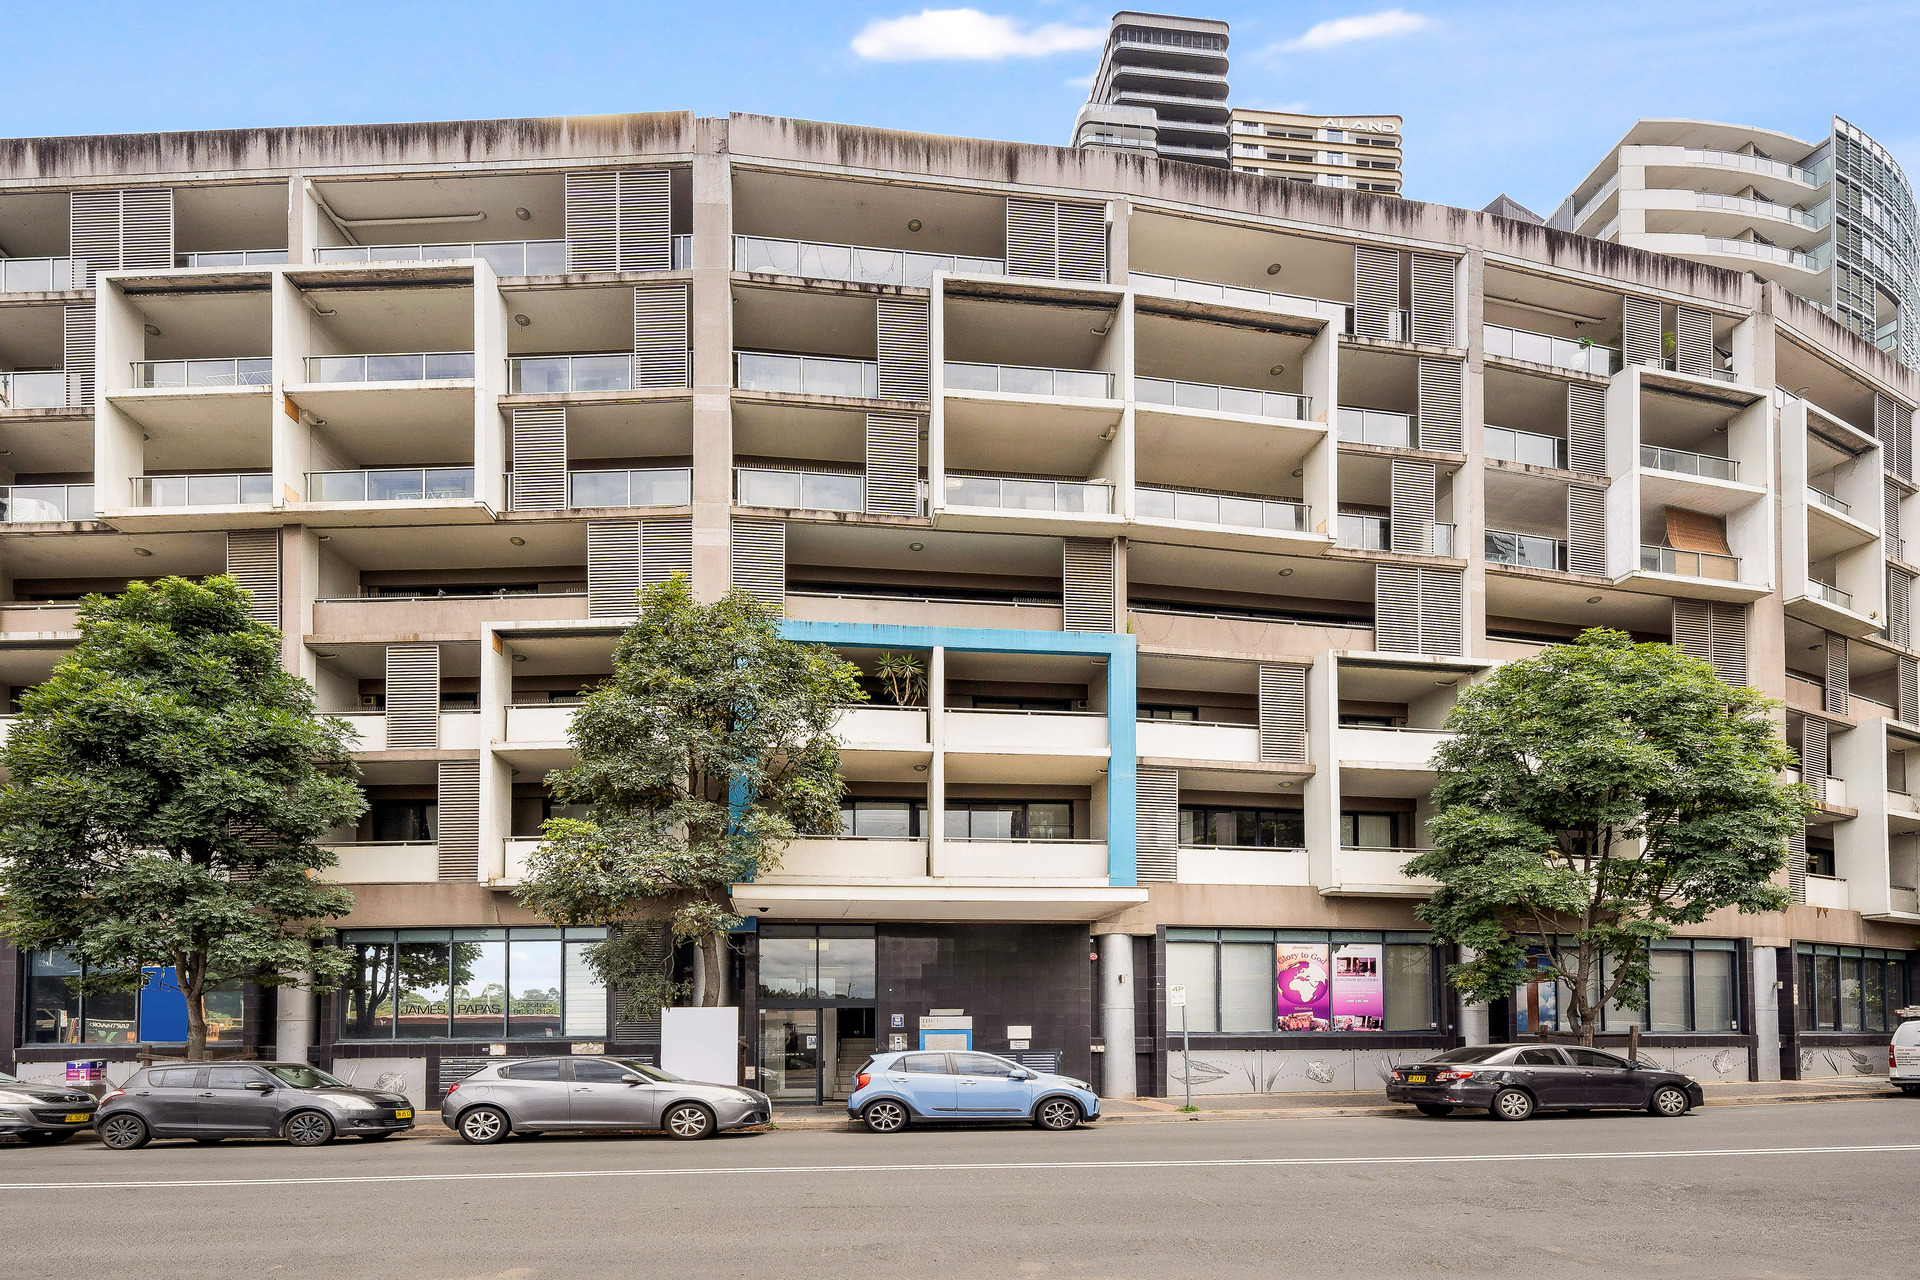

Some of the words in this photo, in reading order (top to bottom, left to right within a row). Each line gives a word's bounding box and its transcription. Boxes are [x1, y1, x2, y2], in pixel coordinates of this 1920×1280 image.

[1321, 117, 1397, 133] ALAND
[1277, 952, 1299, 965] Glory
[1311, 953, 1327, 965] God
[400, 1004, 446, 1015] JAMES
[457, 1003, 501, 1014] PAPAS
